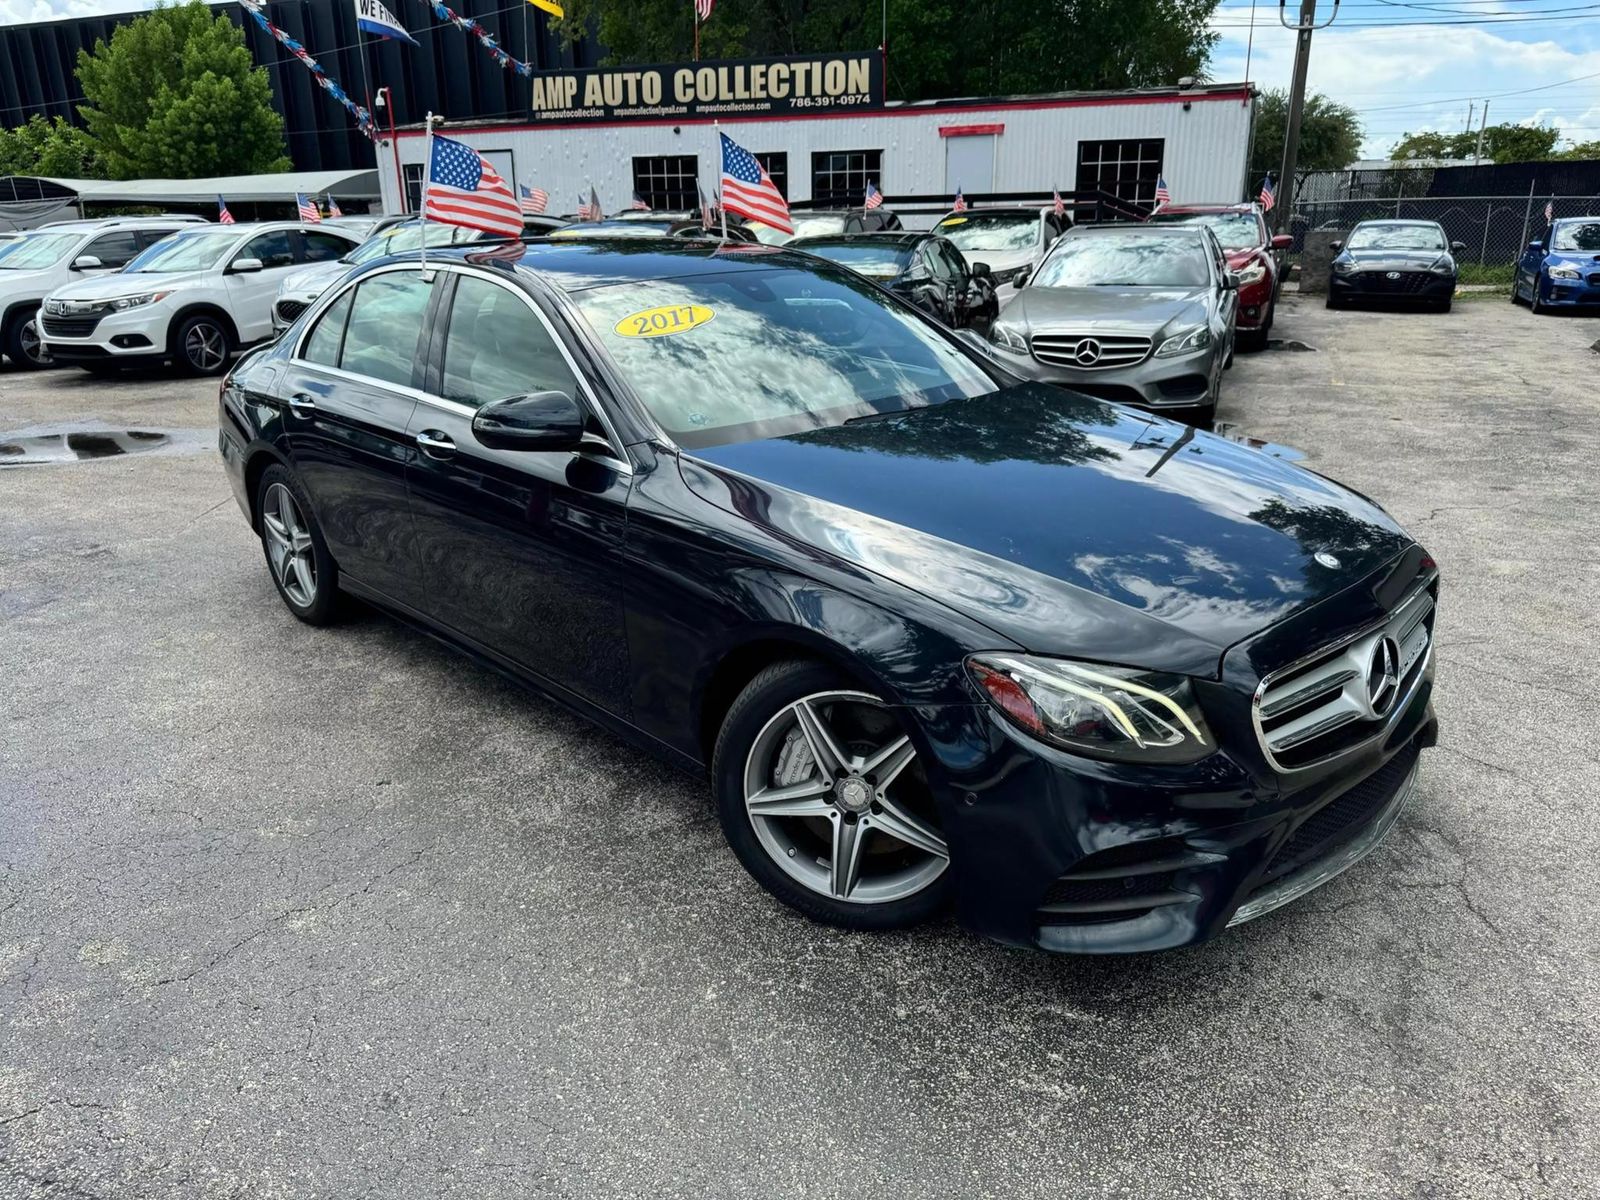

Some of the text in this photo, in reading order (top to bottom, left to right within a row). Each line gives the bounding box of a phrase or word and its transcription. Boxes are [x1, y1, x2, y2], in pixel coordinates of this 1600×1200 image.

[360, 0, 376, 17] WE
[533, 58, 870, 111] AMP AUTO COLLECTION
[695, 102, 771, 114] ampautocollection.com
[789, 95, 871, 109] 786-391-0974
[633, 306, 694, 334] 2017
